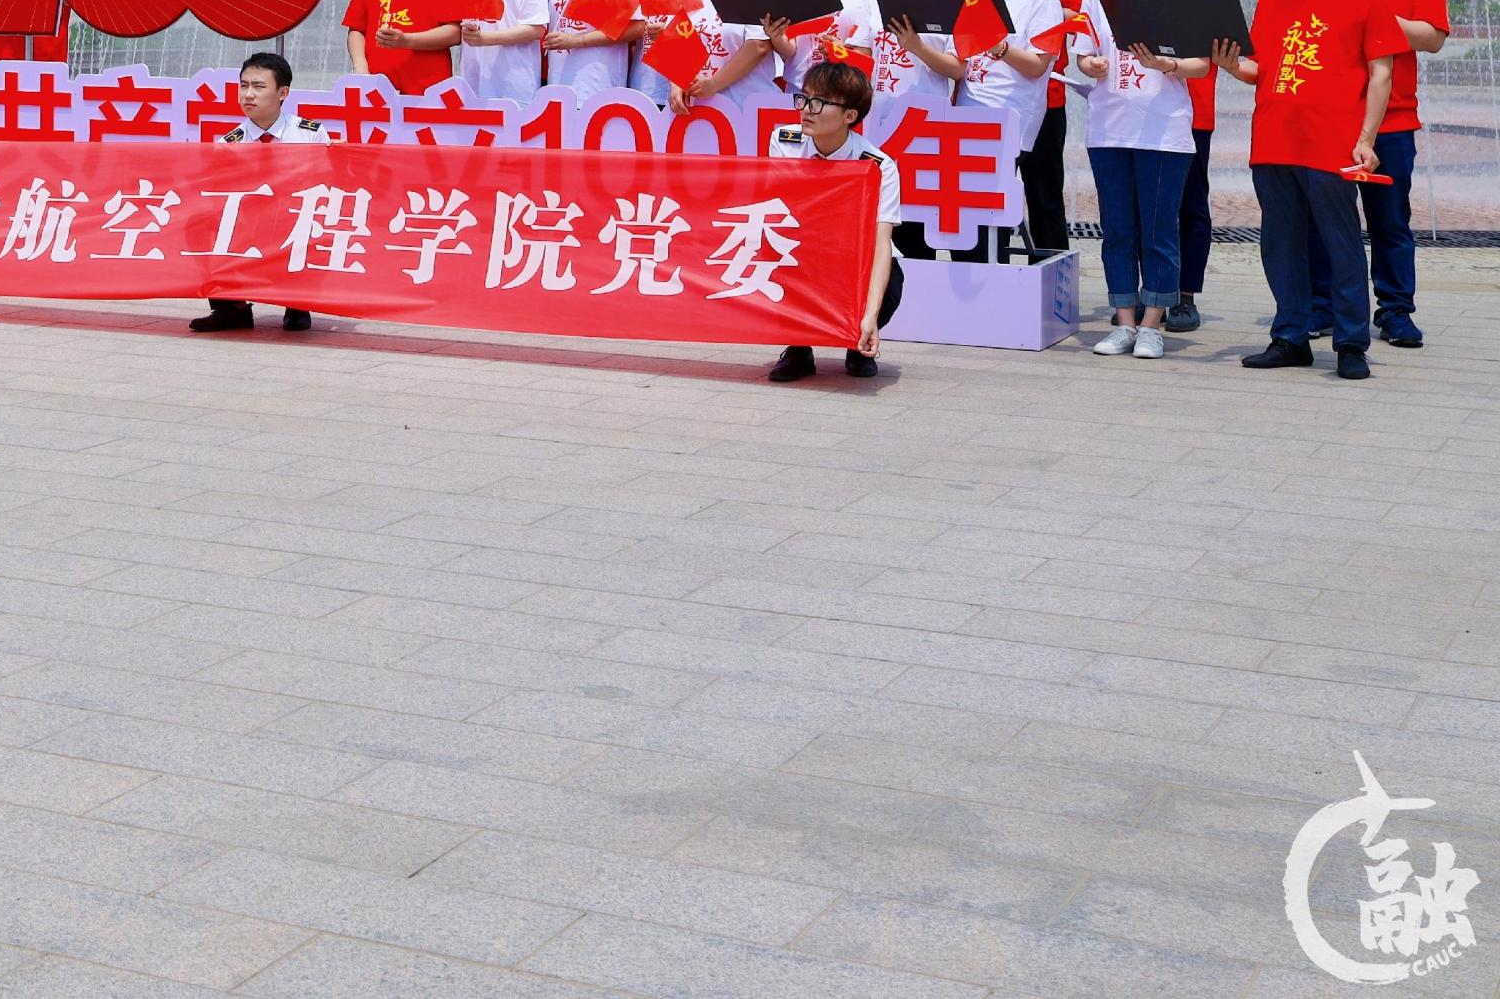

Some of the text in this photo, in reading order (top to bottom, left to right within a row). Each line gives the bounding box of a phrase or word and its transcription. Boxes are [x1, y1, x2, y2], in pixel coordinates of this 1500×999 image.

[874, 30, 916, 69] 永远
[1282, 20, 1324, 71] 永远
[1275, 53, 1296, 94] 跟党走
